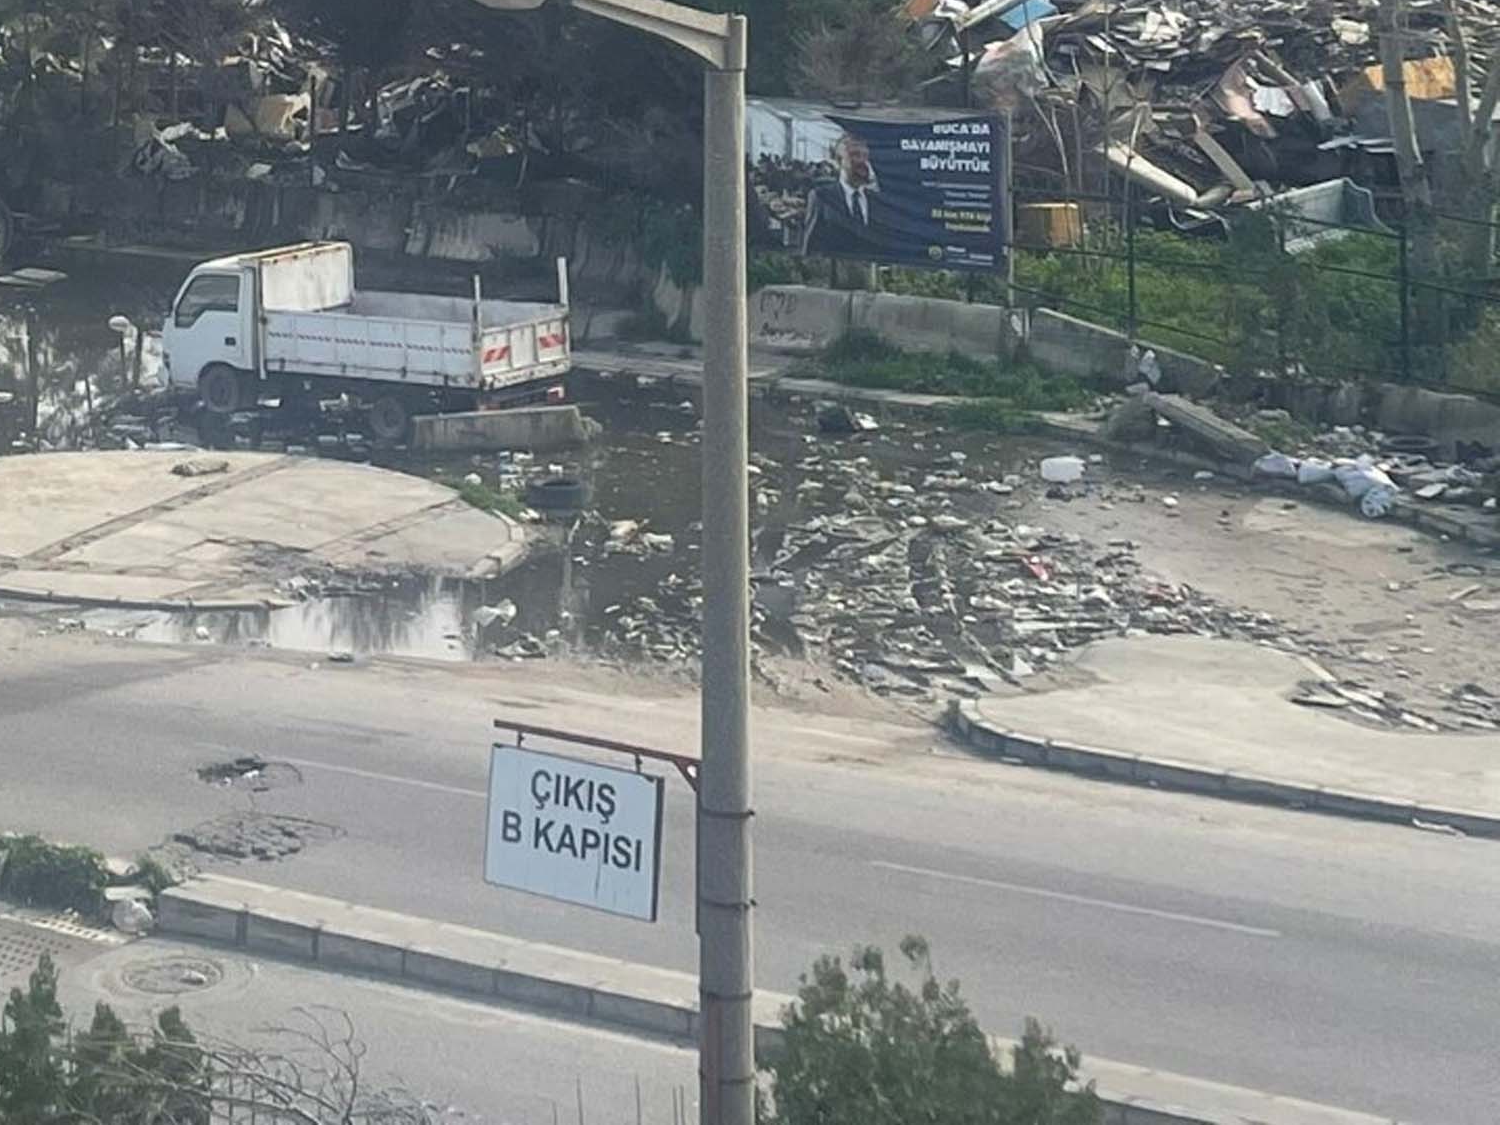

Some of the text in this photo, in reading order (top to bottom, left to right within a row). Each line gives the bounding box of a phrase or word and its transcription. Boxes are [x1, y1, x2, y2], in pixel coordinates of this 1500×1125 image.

[901, 139, 990, 155] DAYANIŞMAYI
[920, 155, 990, 172] BÜYÜTTÜK
[530, 769, 617, 824] ÇIKIŞ
[502, 810, 642, 872] B KAPISI
